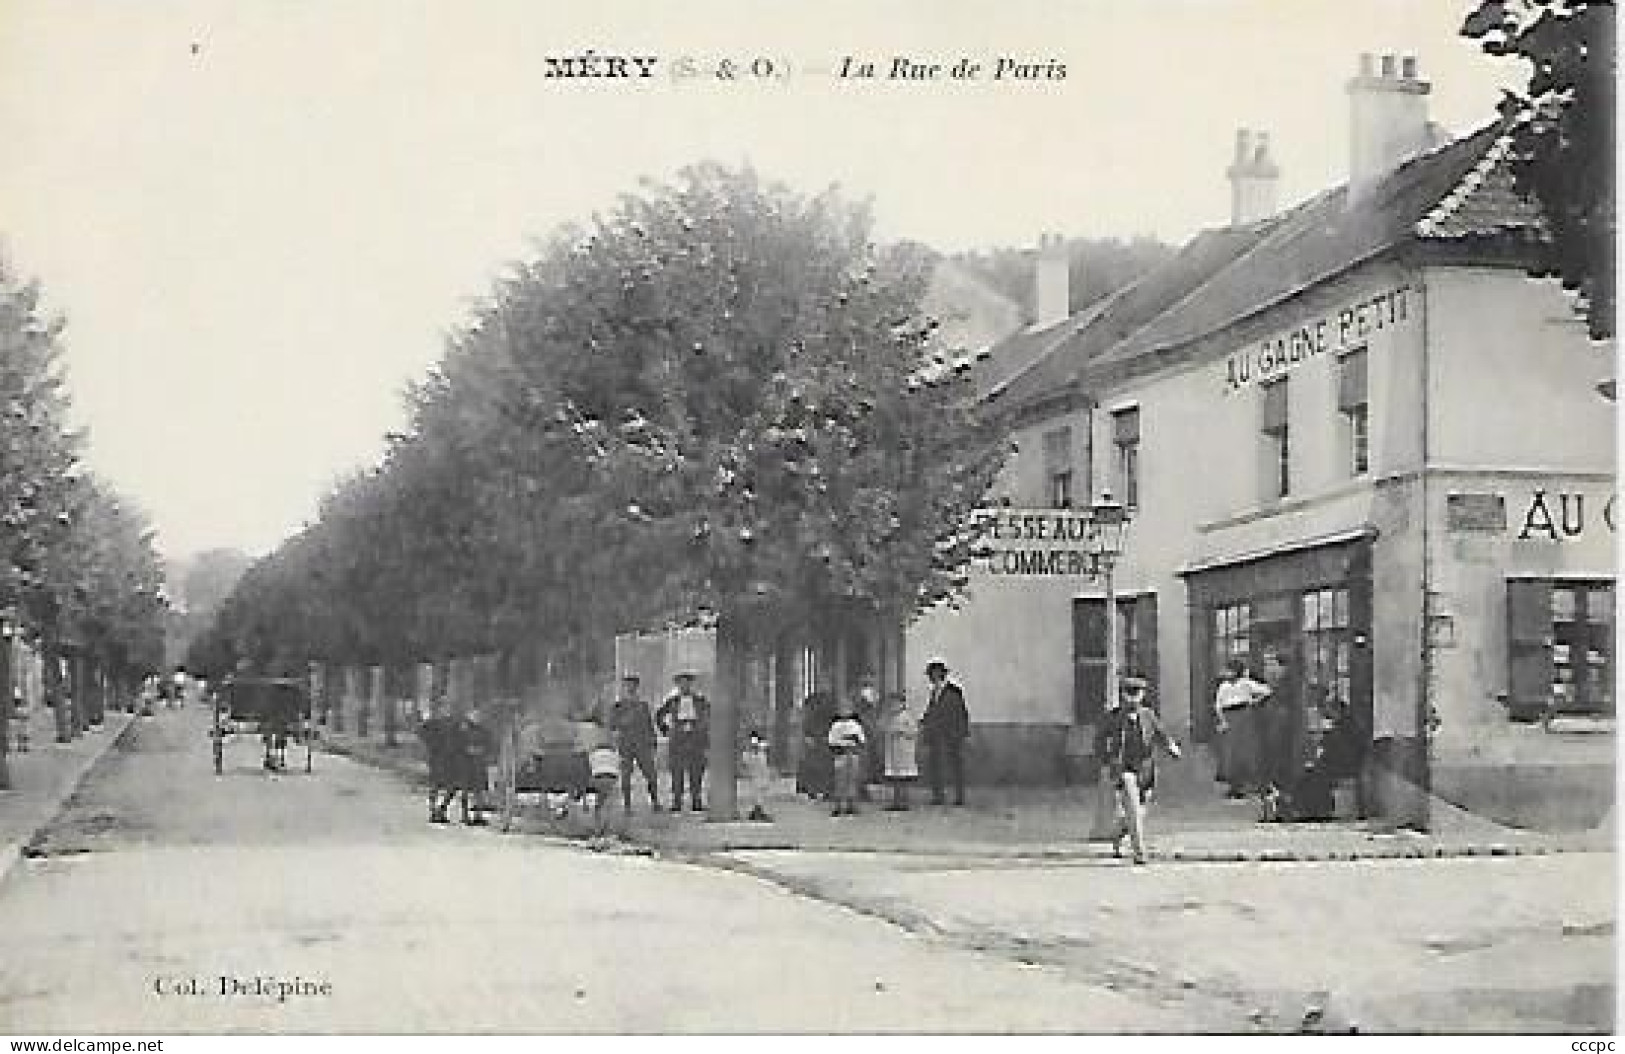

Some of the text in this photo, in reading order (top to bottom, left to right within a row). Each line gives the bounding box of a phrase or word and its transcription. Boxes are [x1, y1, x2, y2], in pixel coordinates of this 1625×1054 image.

[1224, 284, 1412, 393] AU GAGNE PETIT
[1517, 488, 1585, 540] AU
